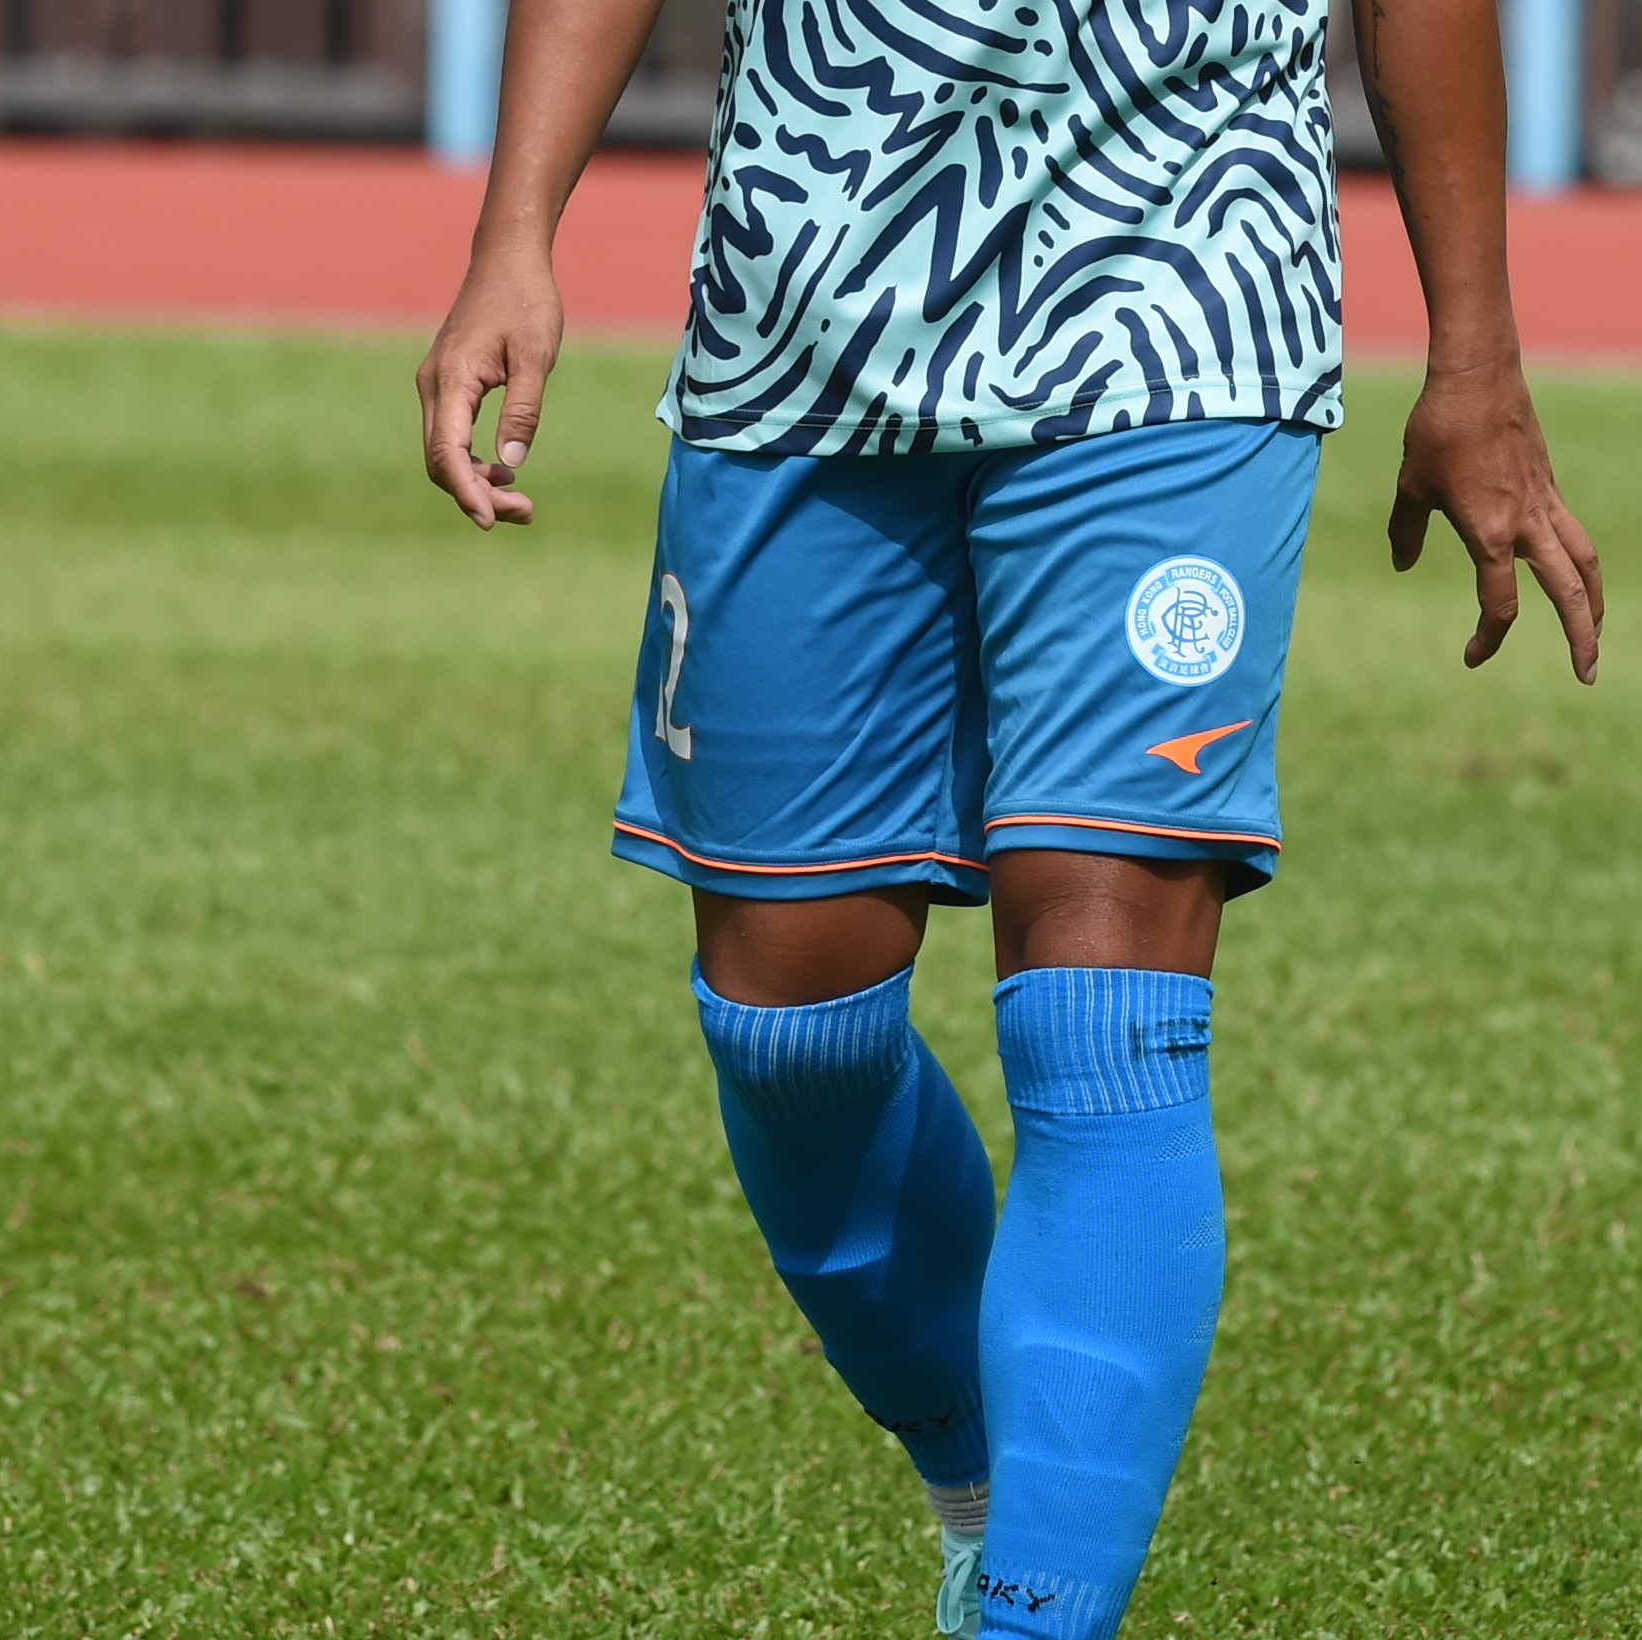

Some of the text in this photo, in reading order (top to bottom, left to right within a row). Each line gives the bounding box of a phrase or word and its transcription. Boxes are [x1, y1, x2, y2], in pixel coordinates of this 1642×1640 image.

[1171, 566, 1218, 585] RANGERS
[1137, 580, 1163, 636] HONG KONG
